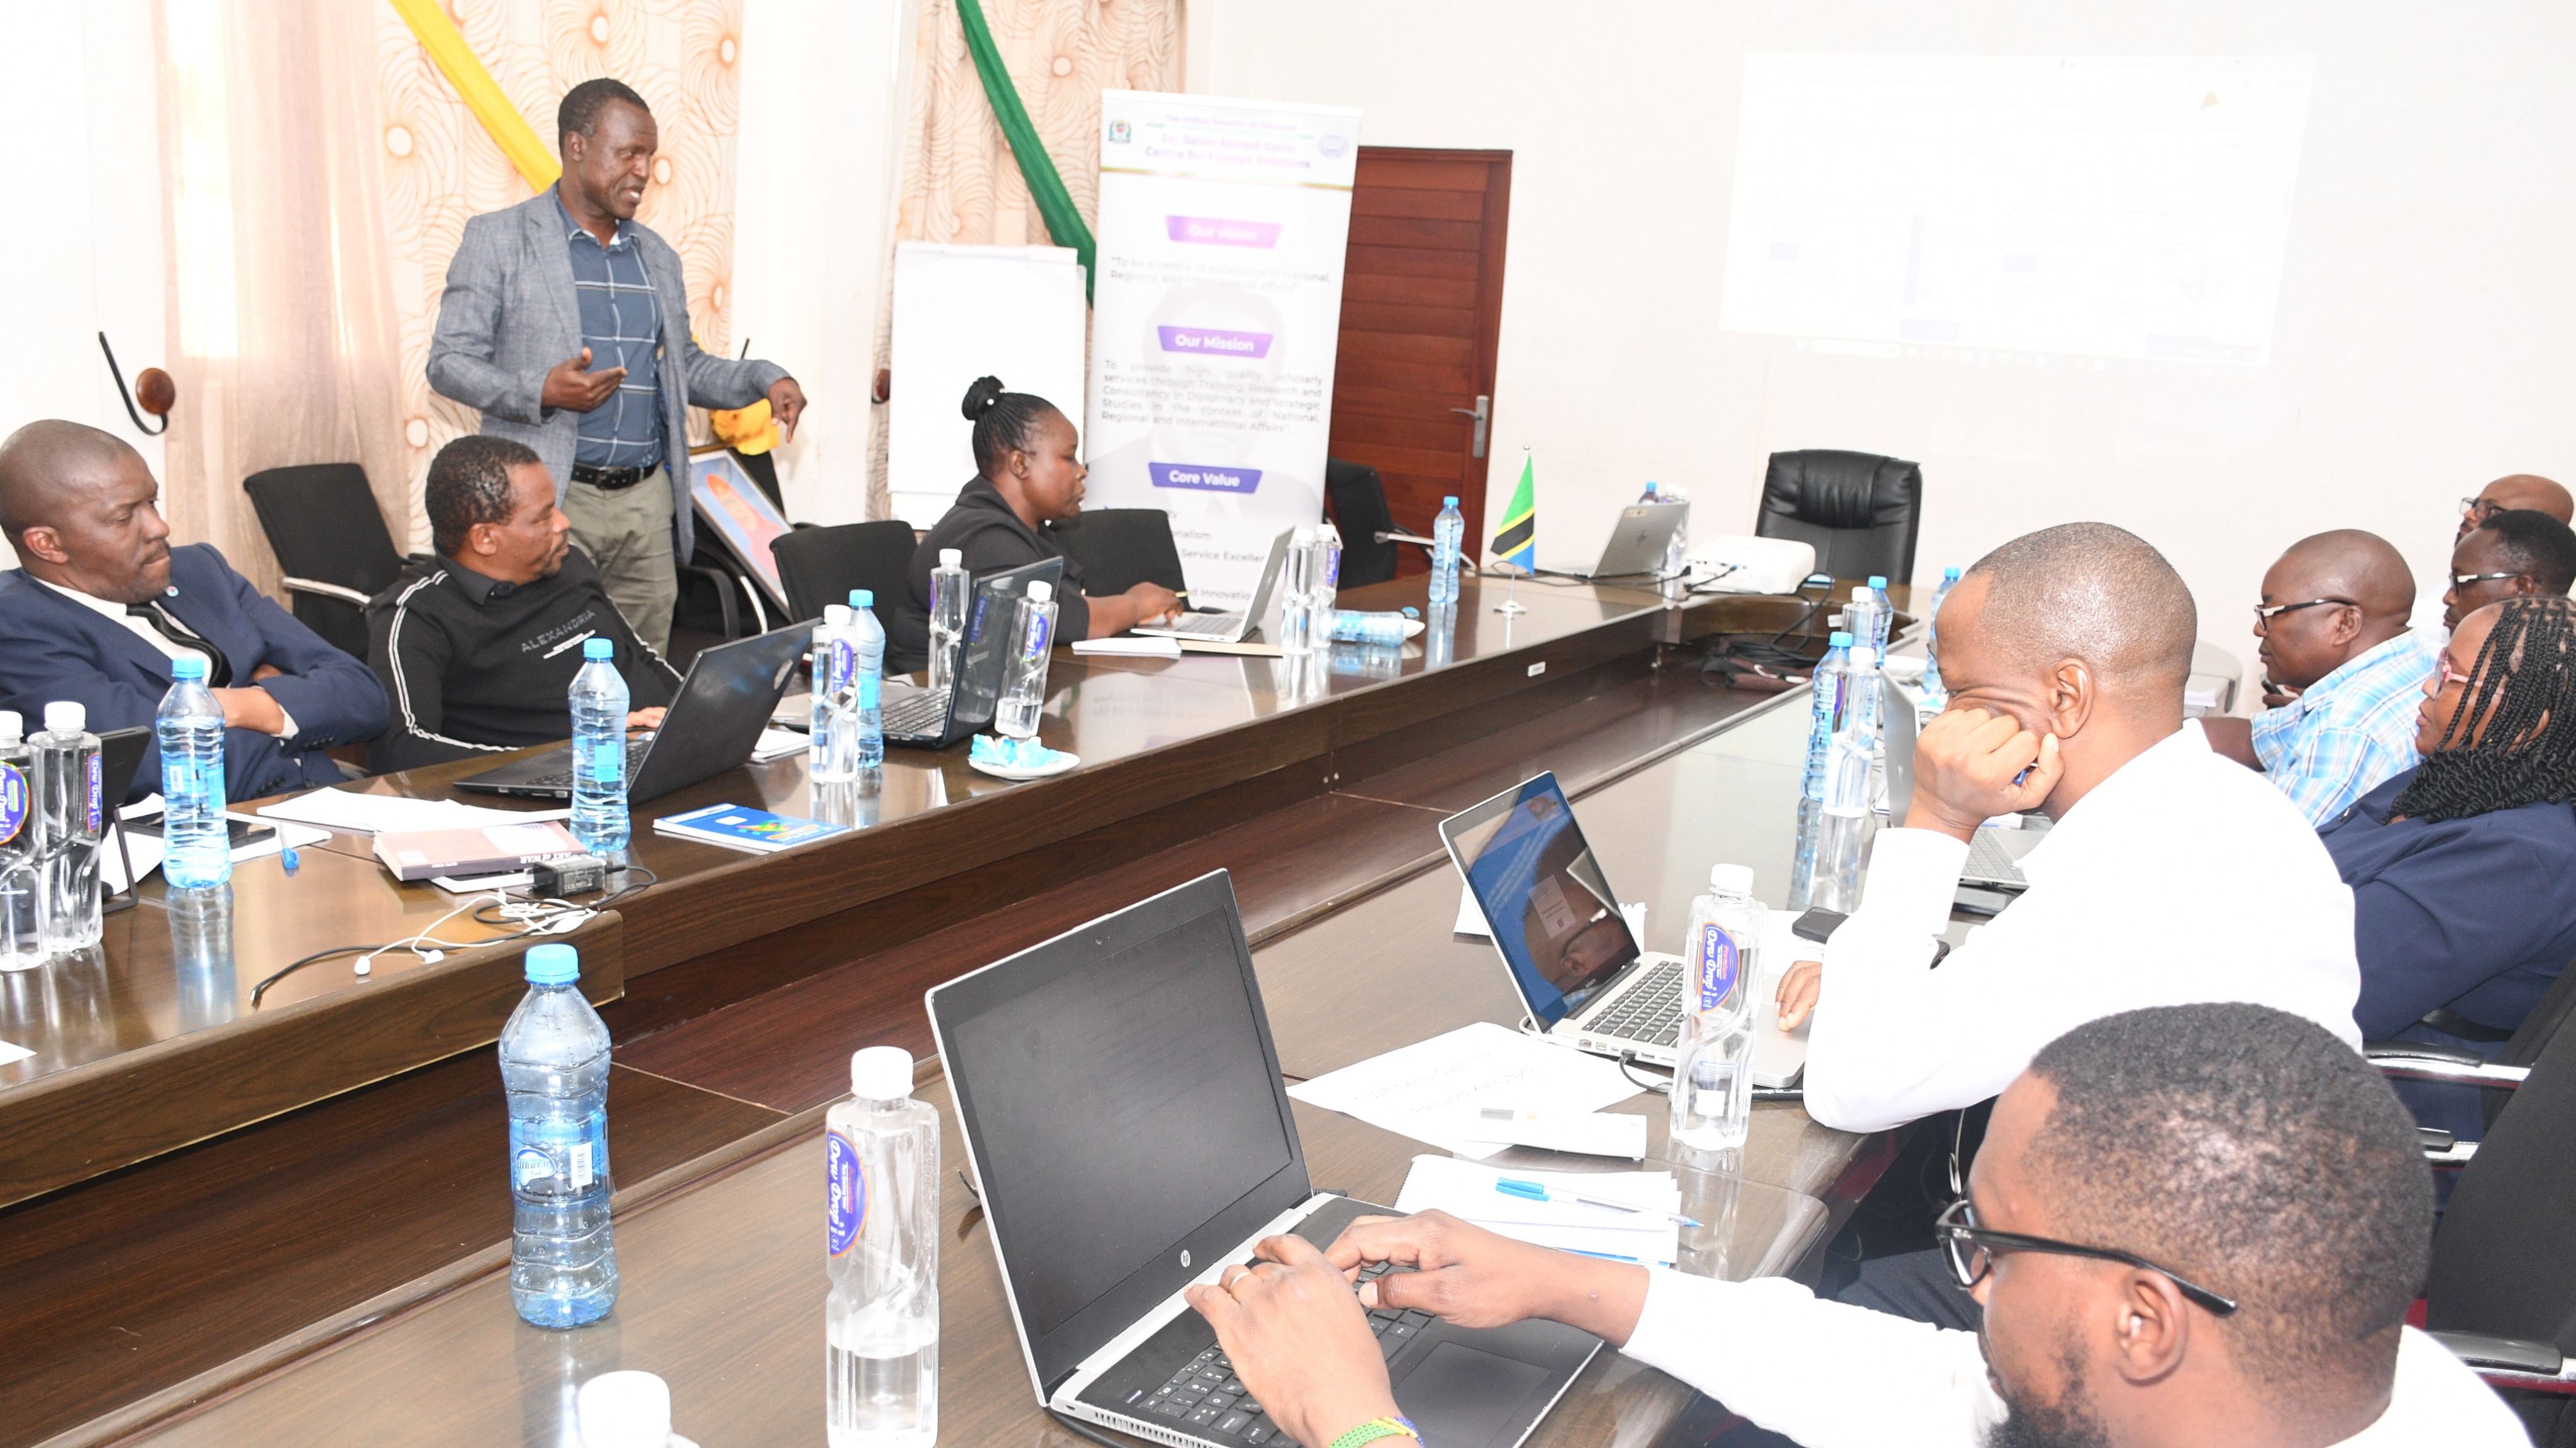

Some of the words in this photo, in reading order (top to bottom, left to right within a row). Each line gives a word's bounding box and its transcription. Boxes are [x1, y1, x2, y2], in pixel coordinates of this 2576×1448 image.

[1162, 133, 1179, 143] Dr.
[1183, 134, 1216, 147] Salim
[1219, 137, 1260, 151] Ahmed
[1263, 140, 1296, 153] Salim
[1145, 146, 1185, 160] Centre
[1187, 148, 1204, 161] for
[1208, 151, 1253, 165] Foreign
[1256, 155, 1312, 169] Relations
[1188, 224, 1214, 238] Our
[1218, 227, 1257, 242] vision
[1110, 268, 1158, 283] Regional
[1161, 272, 1182, 284] and
[1131, 258, 1145, 268] be
[1157, 260, 1192, 272] centre
[1195, 262, 1206, 272] of
[1208, 263, 1268, 278] excellence
[1270, 267, 1280, 278] in
[1283, 268, 1331, 284] National,
[1175, 333, 1201, 347] Our
[1203, 334, 1255, 352] Mission
[1104, 358, 1117, 370] To
[1130, 362, 1172, 373] provide
[1185, 364, 1211, 377] high
[1224, 368, 1263, 382] quality
[1275, 372, 1323, 386] scholarly
[1103, 373, 1147, 385] services
[1150, 375, 1196, 389] through
[1198, 379, 1246, 393] Training,
[1249, 382, 1299, 395] Research
[1302, 387, 1322, 397] and
[1102, 385, 1170, 401] Consultancy
[1174, 389, 1184, 399] in
[1187, 390, 1246, 406] Diplomacy
[1249, 394, 1270, 406] and
[1273, 395, 1321, 411] Strategic
[1101, 398, 1142, 411] Studies
[1152, 401, 1162, 411] in
[1172, 402, 1191, 413] the
[1201, 406, 1242, 417] context
[1252, 408, 1263, 418] of
[1273, 411, 1320, 423] National,
[1101, 411, 1150, 424] Regional
[1153, 413, 1173, 425] and
[1175, 416, 1246, 431] International
[1169, 470, 1200, 485] Core
[1203, 472, 1241, 487] Value
[1181, 548, 1219, 561] Service
[521, 609, 596, 653] ALEXANDRIA
[91, 759, 99, 783] Dew
[90, 785, 100, 812] Drop
[519, 854, 541, 864] WAR
[1706, 929, 1718, 958] Dew
[1702, 959, 1717, 990] Drop
[830, 1139, 841, 1180] Dew
[830, 1183, 841, 1225] Drop
